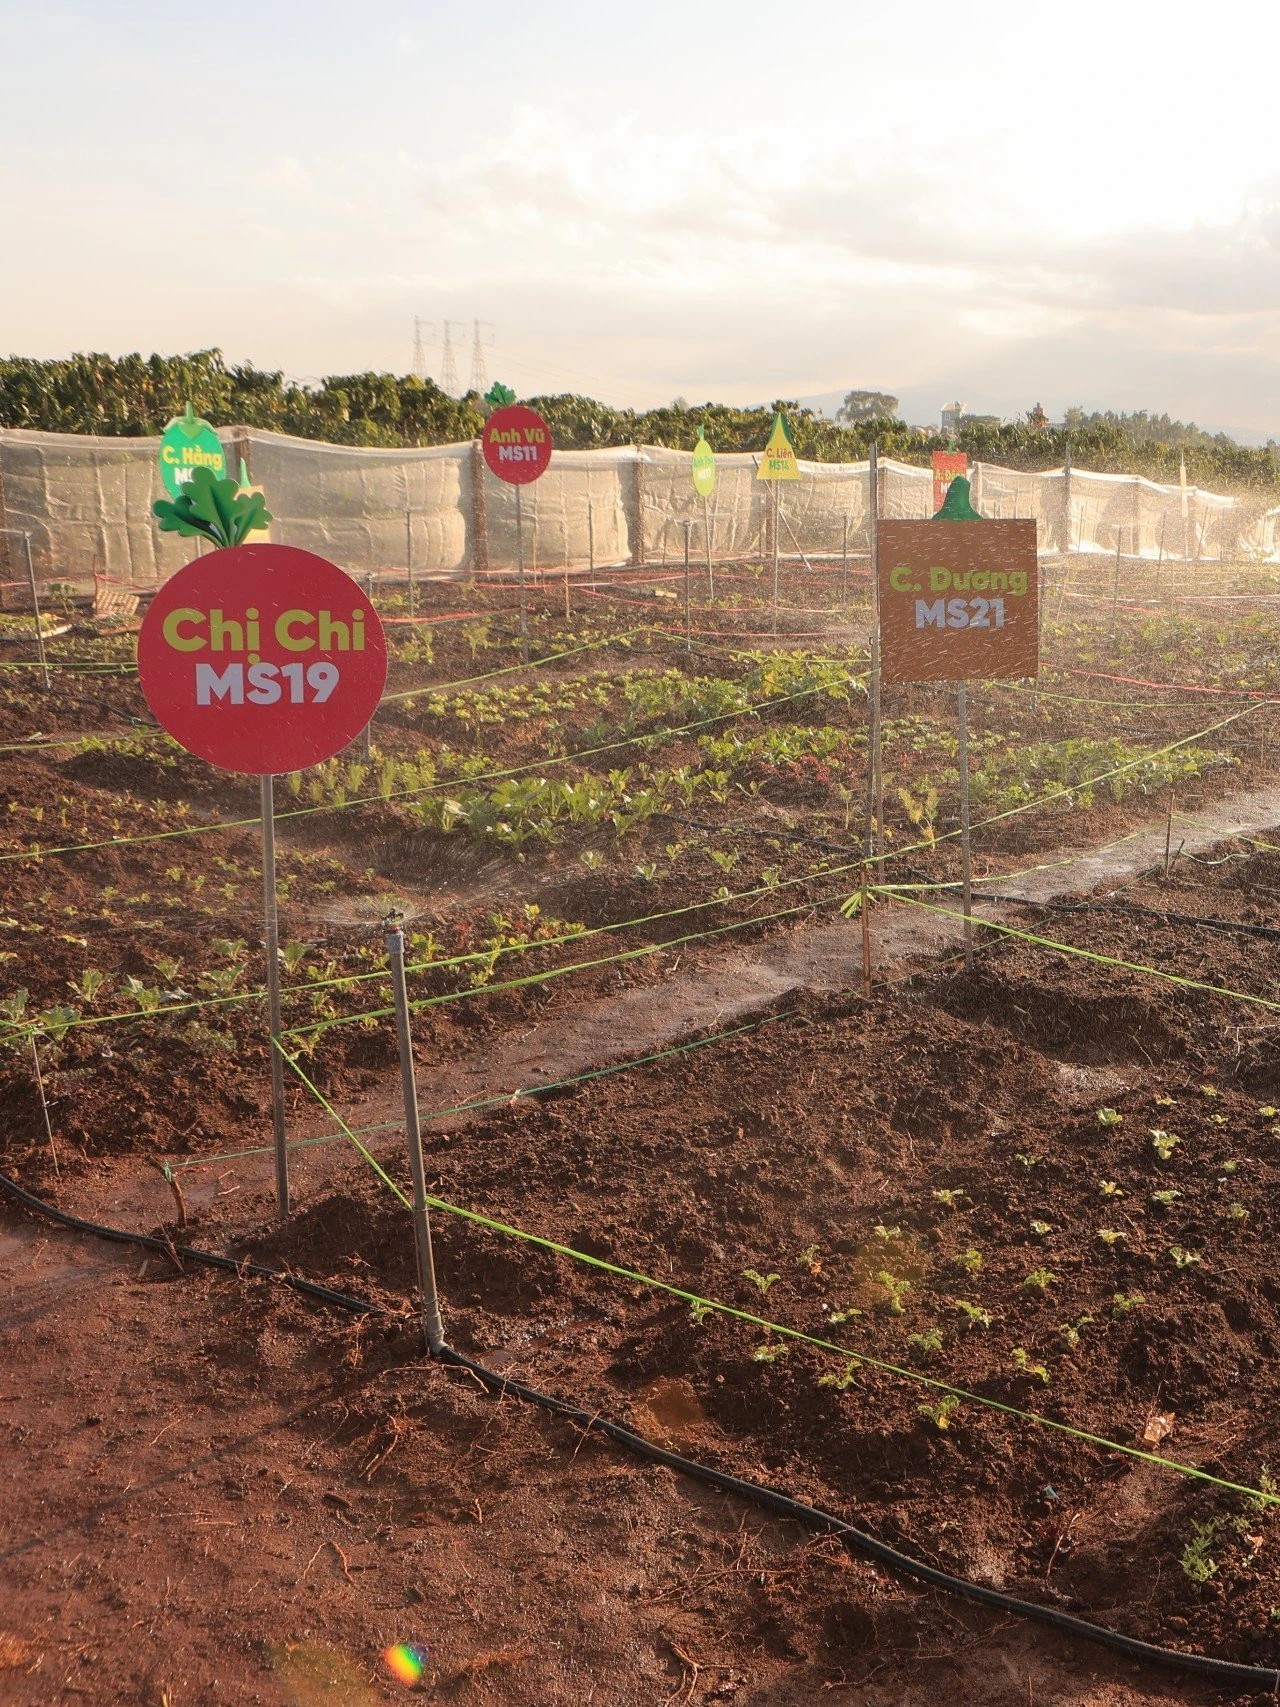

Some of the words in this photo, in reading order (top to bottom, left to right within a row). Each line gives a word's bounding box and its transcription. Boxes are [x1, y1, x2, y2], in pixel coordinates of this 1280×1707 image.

[490, 428, 521, 443] Anh
[162, 446, 179, 464] C.
[499, 446, 537, 461] MS11
[890, 566, 922, 592] C.
[930, 566, 1028, 596] Dương
[915, 599, 1005, 629] MS21
[274, 608, 365, 652] Chi
[195, 661, 340, 706] MS19
